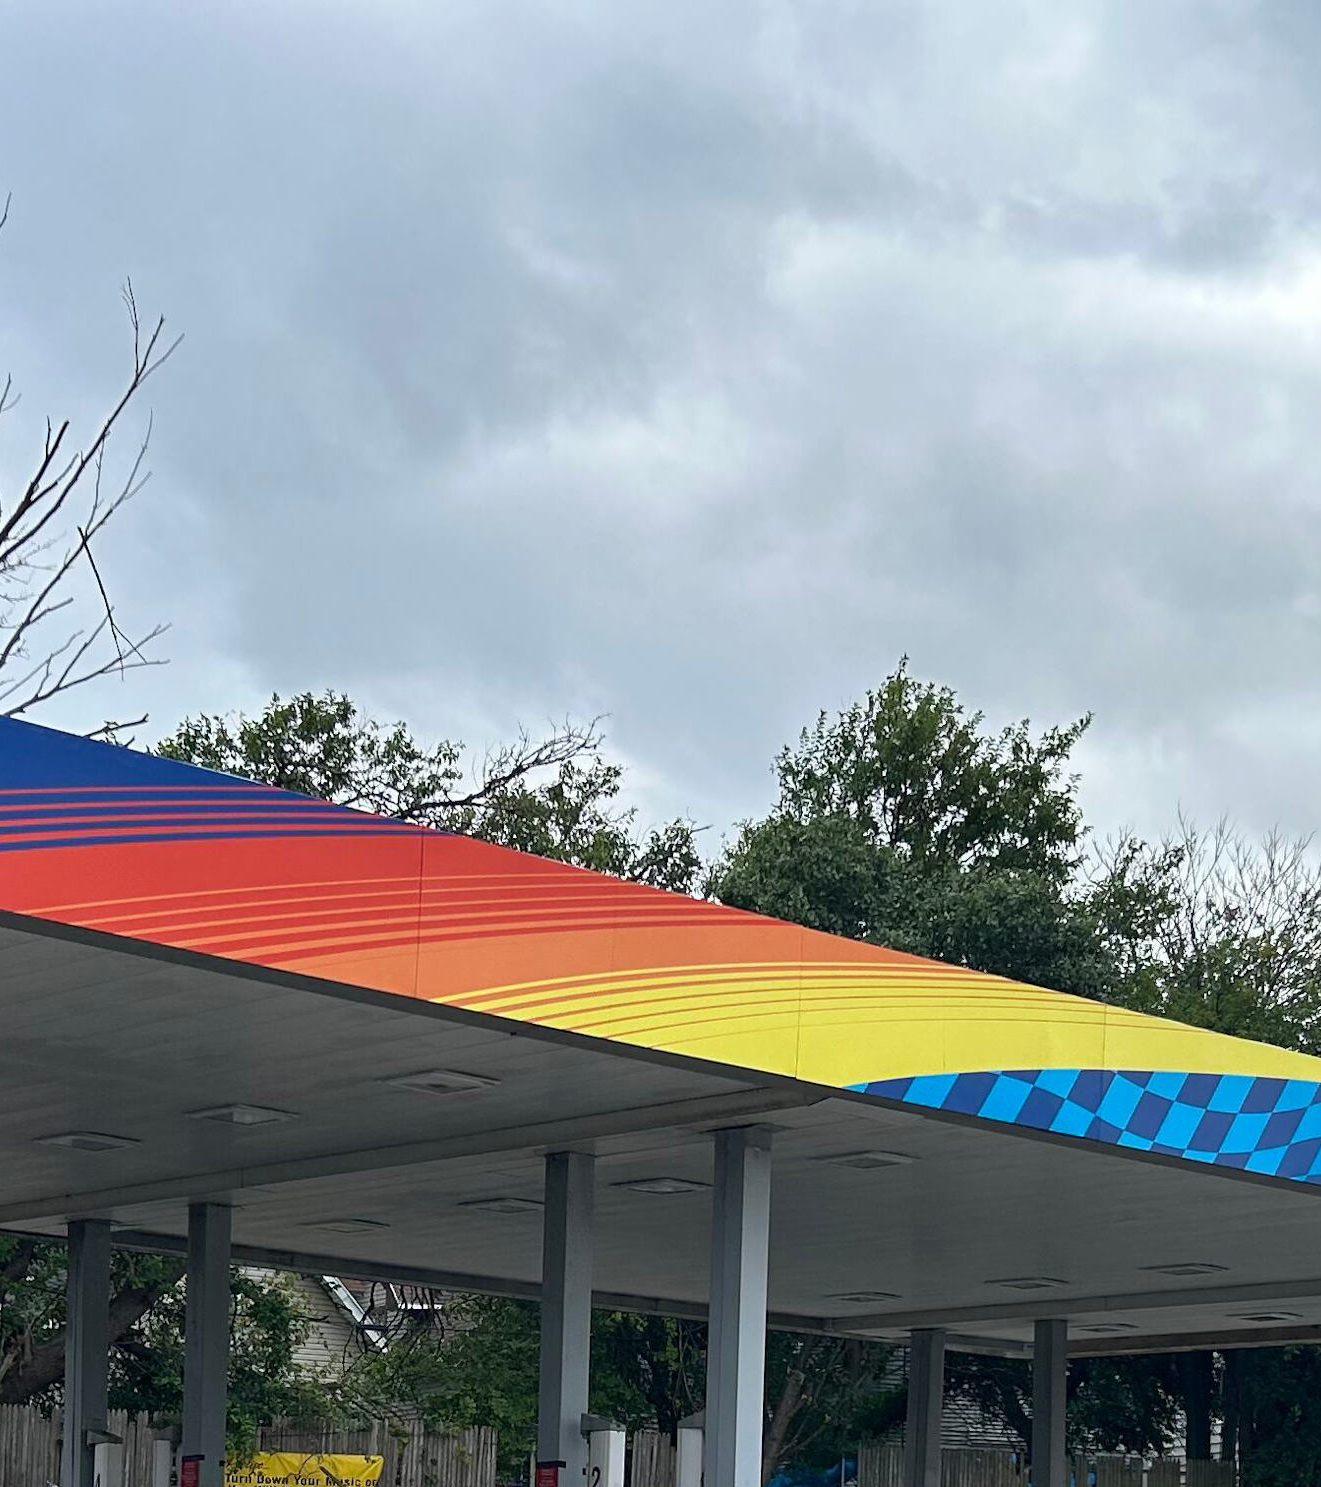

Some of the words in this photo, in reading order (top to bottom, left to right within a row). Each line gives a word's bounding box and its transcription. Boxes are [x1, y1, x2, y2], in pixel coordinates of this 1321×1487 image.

[226, 1474, 251, 1483] Turn
[257, 1474, 289, 1484] Down
[294, 1475, 319, 1486] Your
